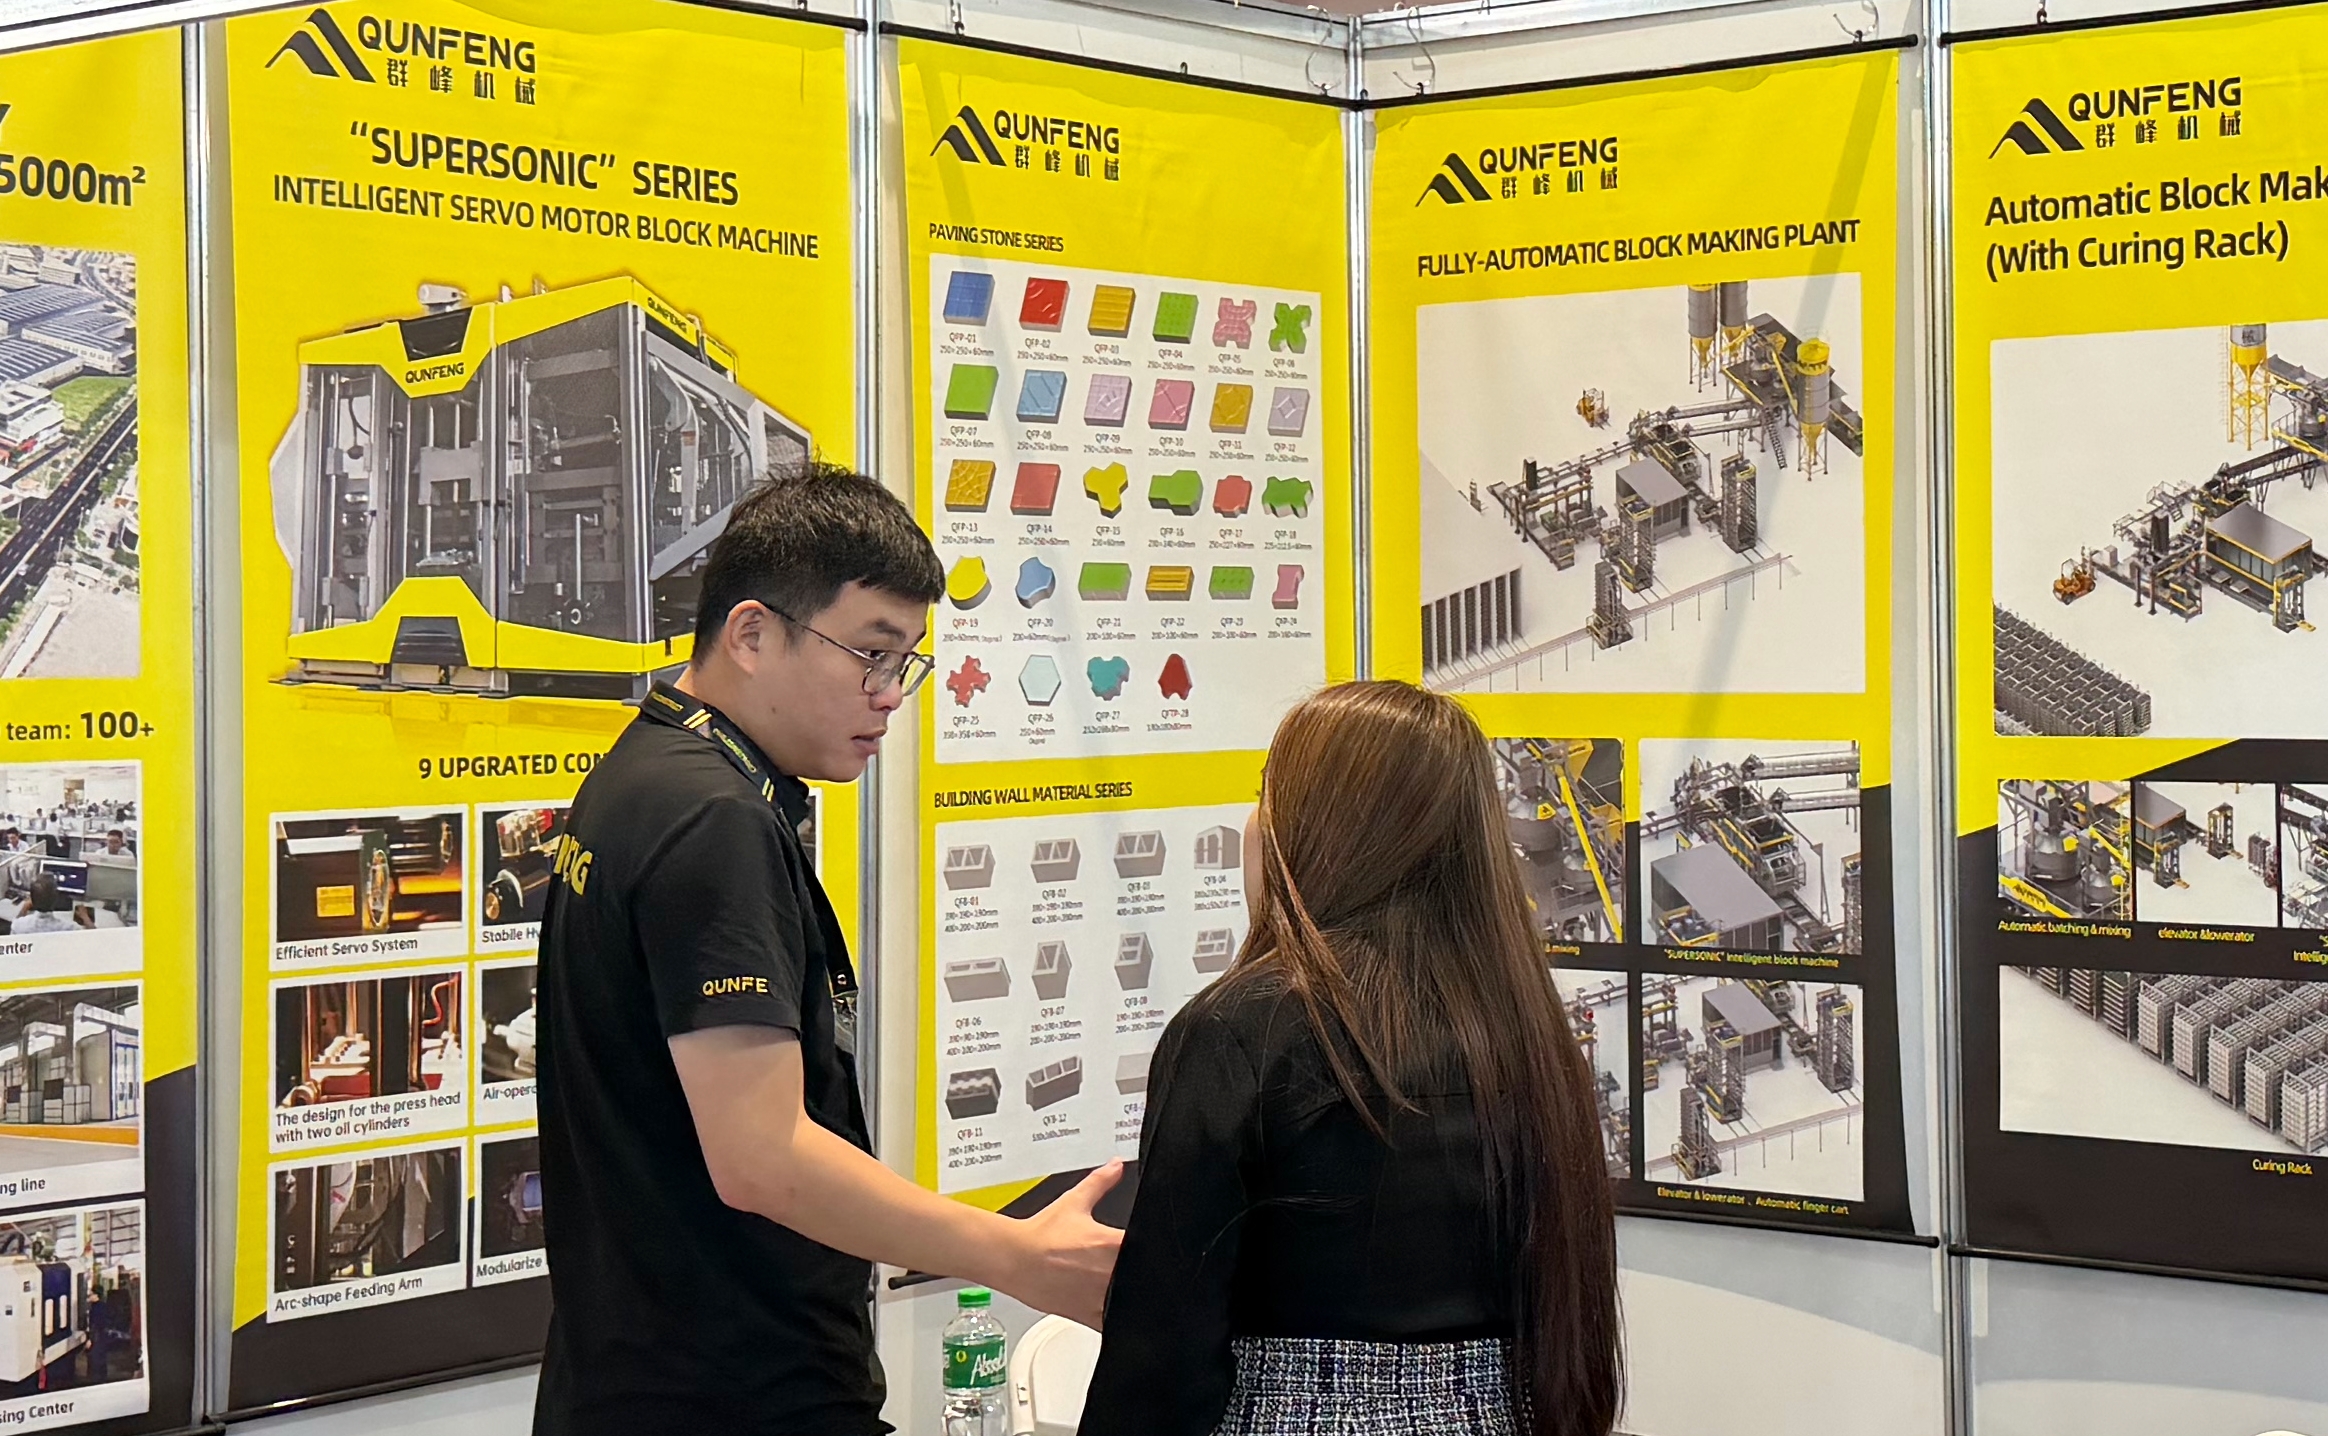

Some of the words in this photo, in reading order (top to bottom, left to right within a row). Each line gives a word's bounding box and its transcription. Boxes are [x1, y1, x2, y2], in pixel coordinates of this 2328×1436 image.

[358, 16, 536, 74] QUNFENG
[2068, 77, 2241, 122] QUNFENG
[994, 110, 1119, 154] QUNFENG
[1480, 137, 1618, 174] QUNFENG
[633, 160, 738, 206] SERIES
[1985, 181, 2150, 226] Automatic
[2160, 177, 2250, 211] Block
[273, 174, 445, 217] INTELLIGENT
[450, 194, 535, 229] SERVO
[541, 204, 631, 239] MOTOR
[636, 215, 712, 247] BLOCK
[717, 224, 819, 259] MACHINE
[929, 222, 978, 243] PAVING
[980, 228, 1022, 247] STONE
[1024, 233, 1064, 252] SERIES
[1418, 240, 1610, 277] FULLY-AUTOMATIC
[1614, 233, 1683, 262] BLOCK
[1687, 225, 1779, 255] MAKING
[1784, 219, 1861, 247] PLANT
[1986, 238, 2069, 282] (With
[2078, 231, 2184, 269] Curing
[2194, 219, 2289, 262] Rack)
[405, 362, 465, 384] QUNFENG
[7, 723, 71, 741] team:
[80, 711, 154, 739] 100+
[419, 758, 431, 779] 9
[439, 754, 557, 778] UPGRATED
[934, 790, 992, 808] BUILDING
[994, 787, 1030, 804] WALL
[1032, 784, 1093, 802] MATERIAL
[1095, 782, 1132, 798] SERIES
[1998, 920, 2047, 933] Automatic
[276, 944, 328, 960] Efficient
[331, 941, 369, 956] Servo
[372, 938, 418, 954] System
[1774, 954, 1799, 965] block
[1800, 957, 1840, 968] machine
[702, 976, 769, 997] QUNFE
[276, 1112, 299, 1127] The
[302, 1106, 346, 1124] design
[349, 1104, 367, 1118] for
[370, 1098, 391, 1115] the
[393, 1096, 427, 1114] press
[429, 1091, 461, 1107] head
[276, 1129, 303, 1144] with
[307, 1125, 332, 1141] two
[353, 1115, 410, 1136] cylinders
[2252, 1158, 2286, 1175] Curing
[2287, 1162, 2313, 1175] Rack
[21, 1177, 46, 1191] line
[1756, 1197, 1800, 1210] Automatic
[1802, 1201, 1829, 1214] finger
[1831, 1206, 1849, 1215] cart
[476, 1256, 542, 1277] Modularize
[275, 1291, 342, 1312] Arc-shape
[345, 1280, 396, 1300] Feeding
[398, 1276, 423, 1291] Arm
[29, 1401, 74, 1418] Center
